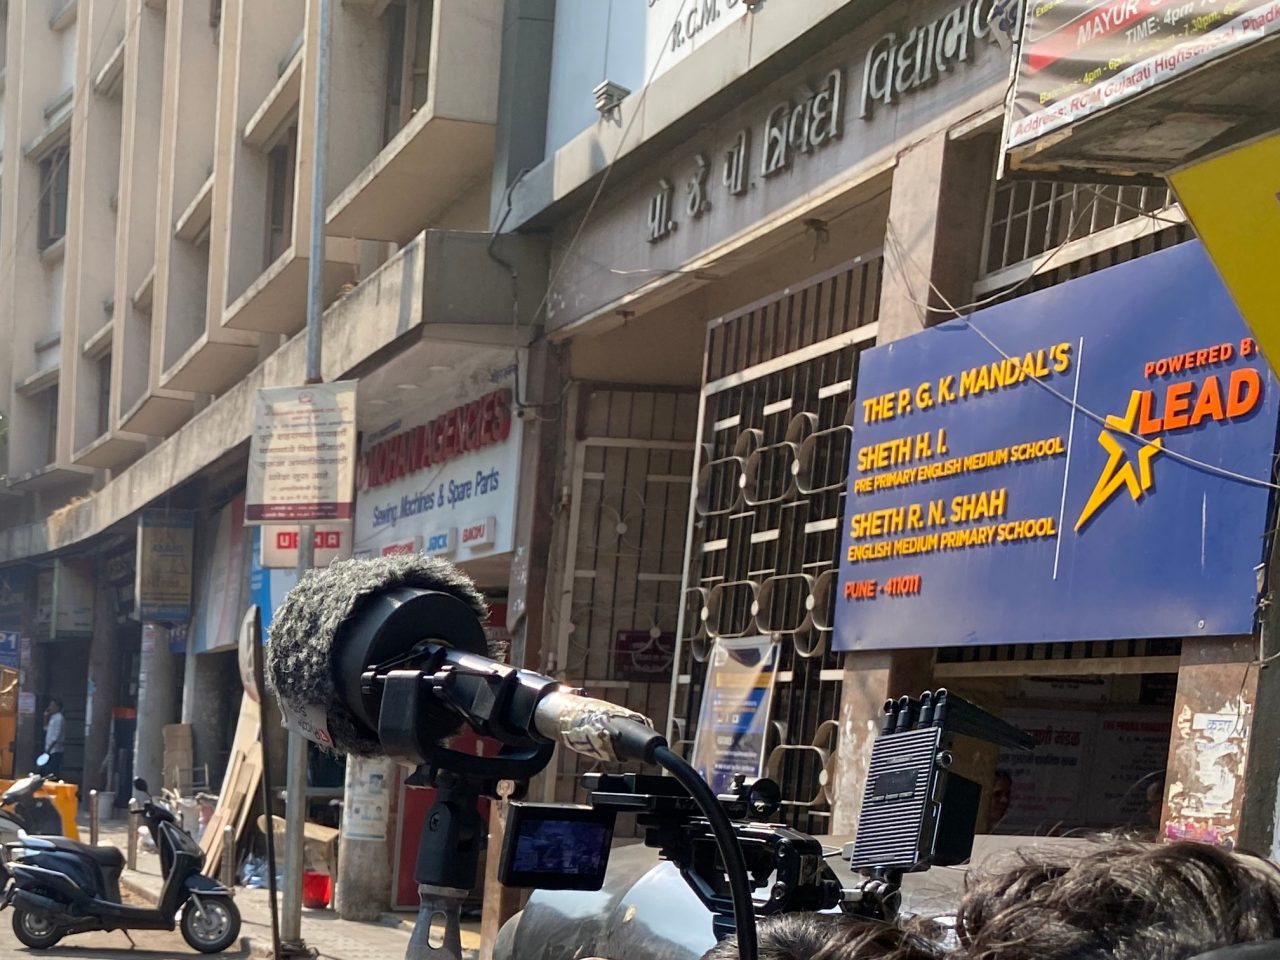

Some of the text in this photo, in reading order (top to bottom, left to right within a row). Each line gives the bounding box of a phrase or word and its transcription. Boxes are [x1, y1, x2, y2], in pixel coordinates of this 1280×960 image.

[1077, 0, 1138, 47] MAYUR
[1125, 17, 1160, 44] TIME:
[1163, 1, 1194, 26] 4pm
[1104, 63, 1151, 98] Gujarati
[1144, 337, 1260, 379] POWERED B
[863, 342, 1072, 424] THE P. G. K. MANDAL'S
[1138, 368, 1261, 435] LEAD
[417, 387, 513, 470] AGENCIES
[857, 435, 913, 472] SHETH
[915, 431, 932, 458] H.
[854, 436, 1064, 494] PRE PRIMARY ENGLISH MEDIUM SCHOOL
[372, 466, 500, 528] Sewing Machines & Spare Parts
[850, 488, 1008, 539] SHETH R. N. SHAH
[847, 517, 1057, 562] ENGLISH MEDIUM PRIMARY SCHOOL
[844, 579, 876, 599] PUNE
[884, 575, 921, 597] 411011
